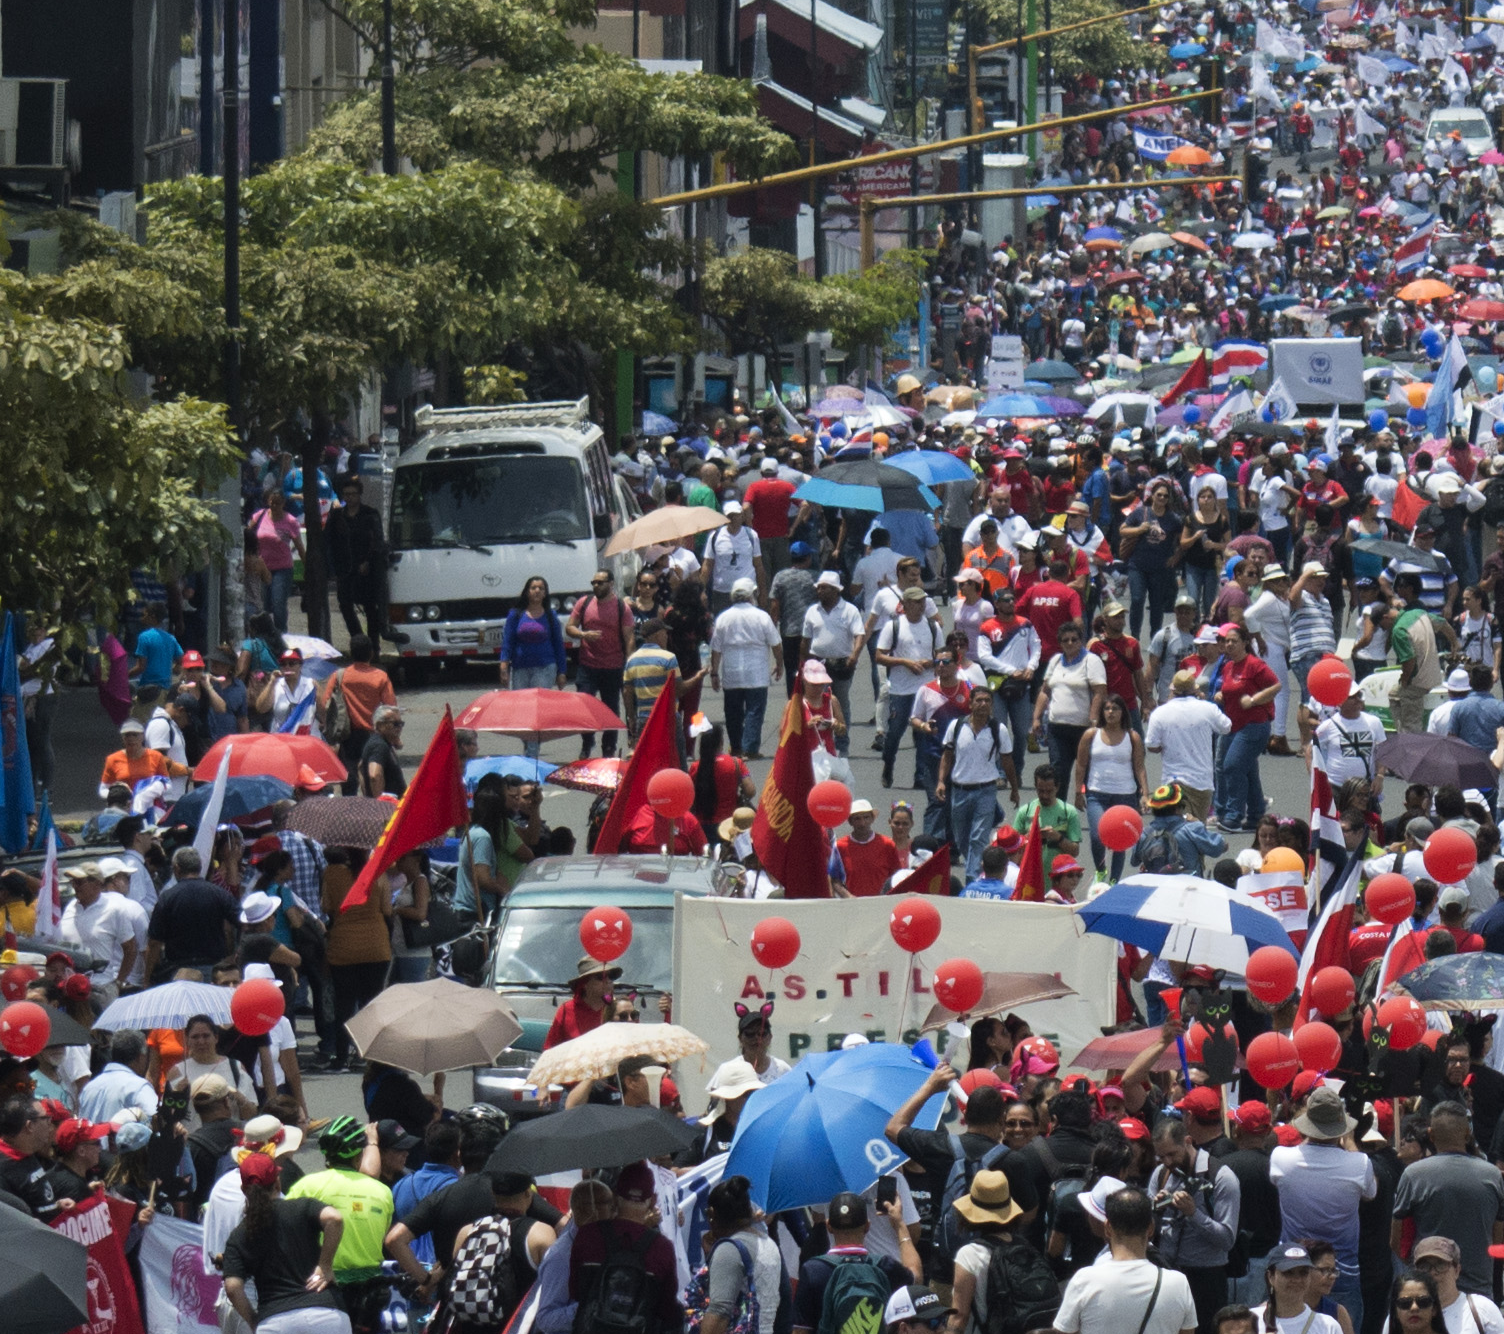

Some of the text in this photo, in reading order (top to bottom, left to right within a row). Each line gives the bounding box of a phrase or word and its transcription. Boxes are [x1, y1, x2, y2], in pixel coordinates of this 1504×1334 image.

[1033, 597, 1059, 607] APSE
[1265, 890, 1297, 909] SE
[1359, 931, 1385, 940] COSTA
